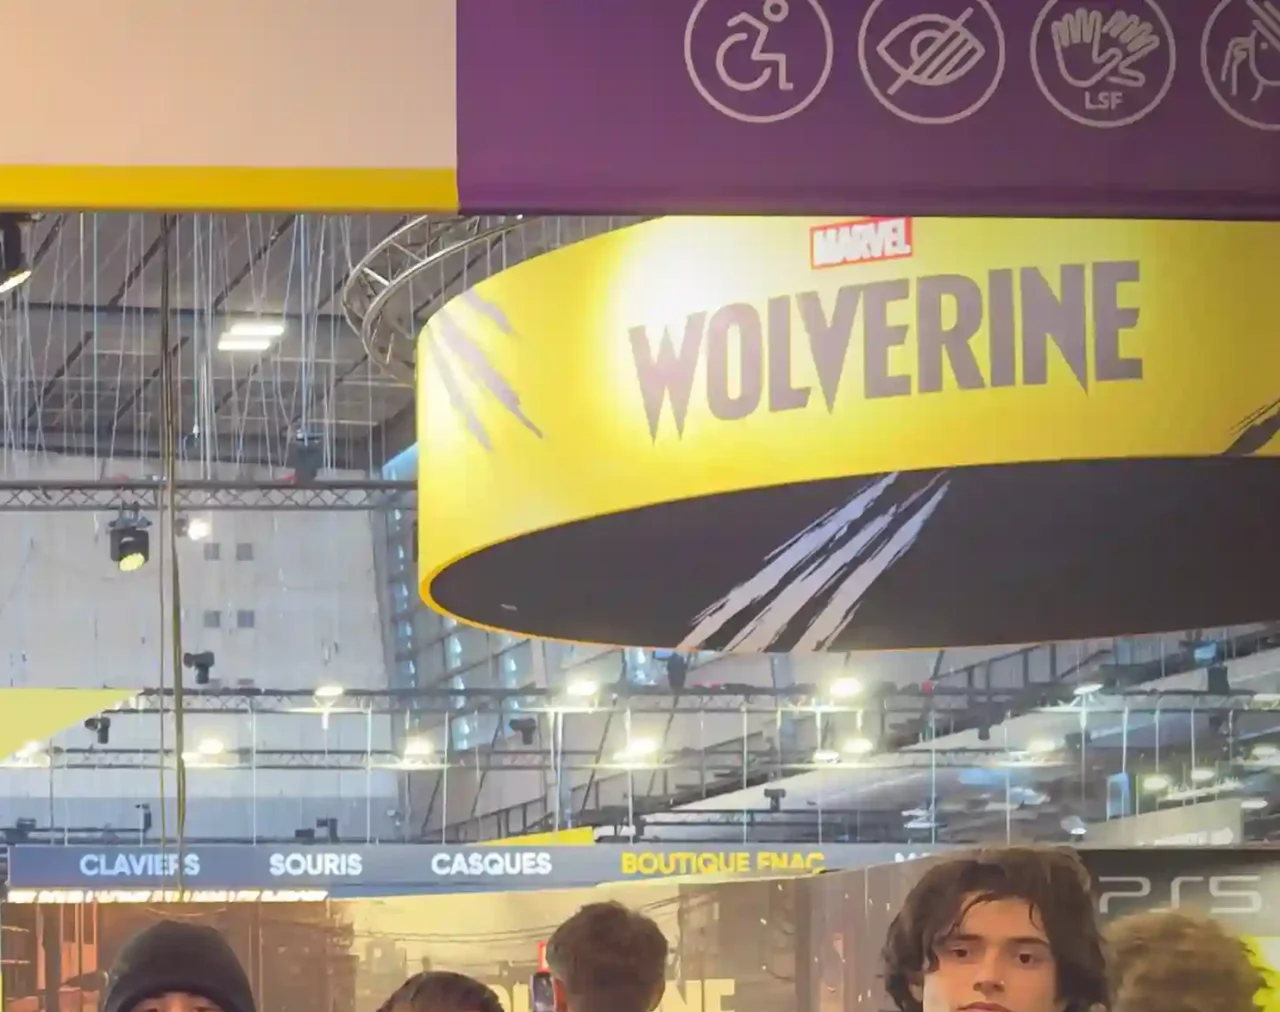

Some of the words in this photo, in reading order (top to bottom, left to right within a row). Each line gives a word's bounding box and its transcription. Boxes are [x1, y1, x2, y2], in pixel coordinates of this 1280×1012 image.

[1084, 91, 1123, 110] LSF
[813, 217, 911, 266] MARVEL
[628, 260, 1144, 447] WOLVERINE
[269, 853, 363, 876] SOURIS
[430, 852, 552, 876] CASQUES
[622, 852, 750, 874] BOUTIQUE
[1098, 874, 1262, 914] PS5
